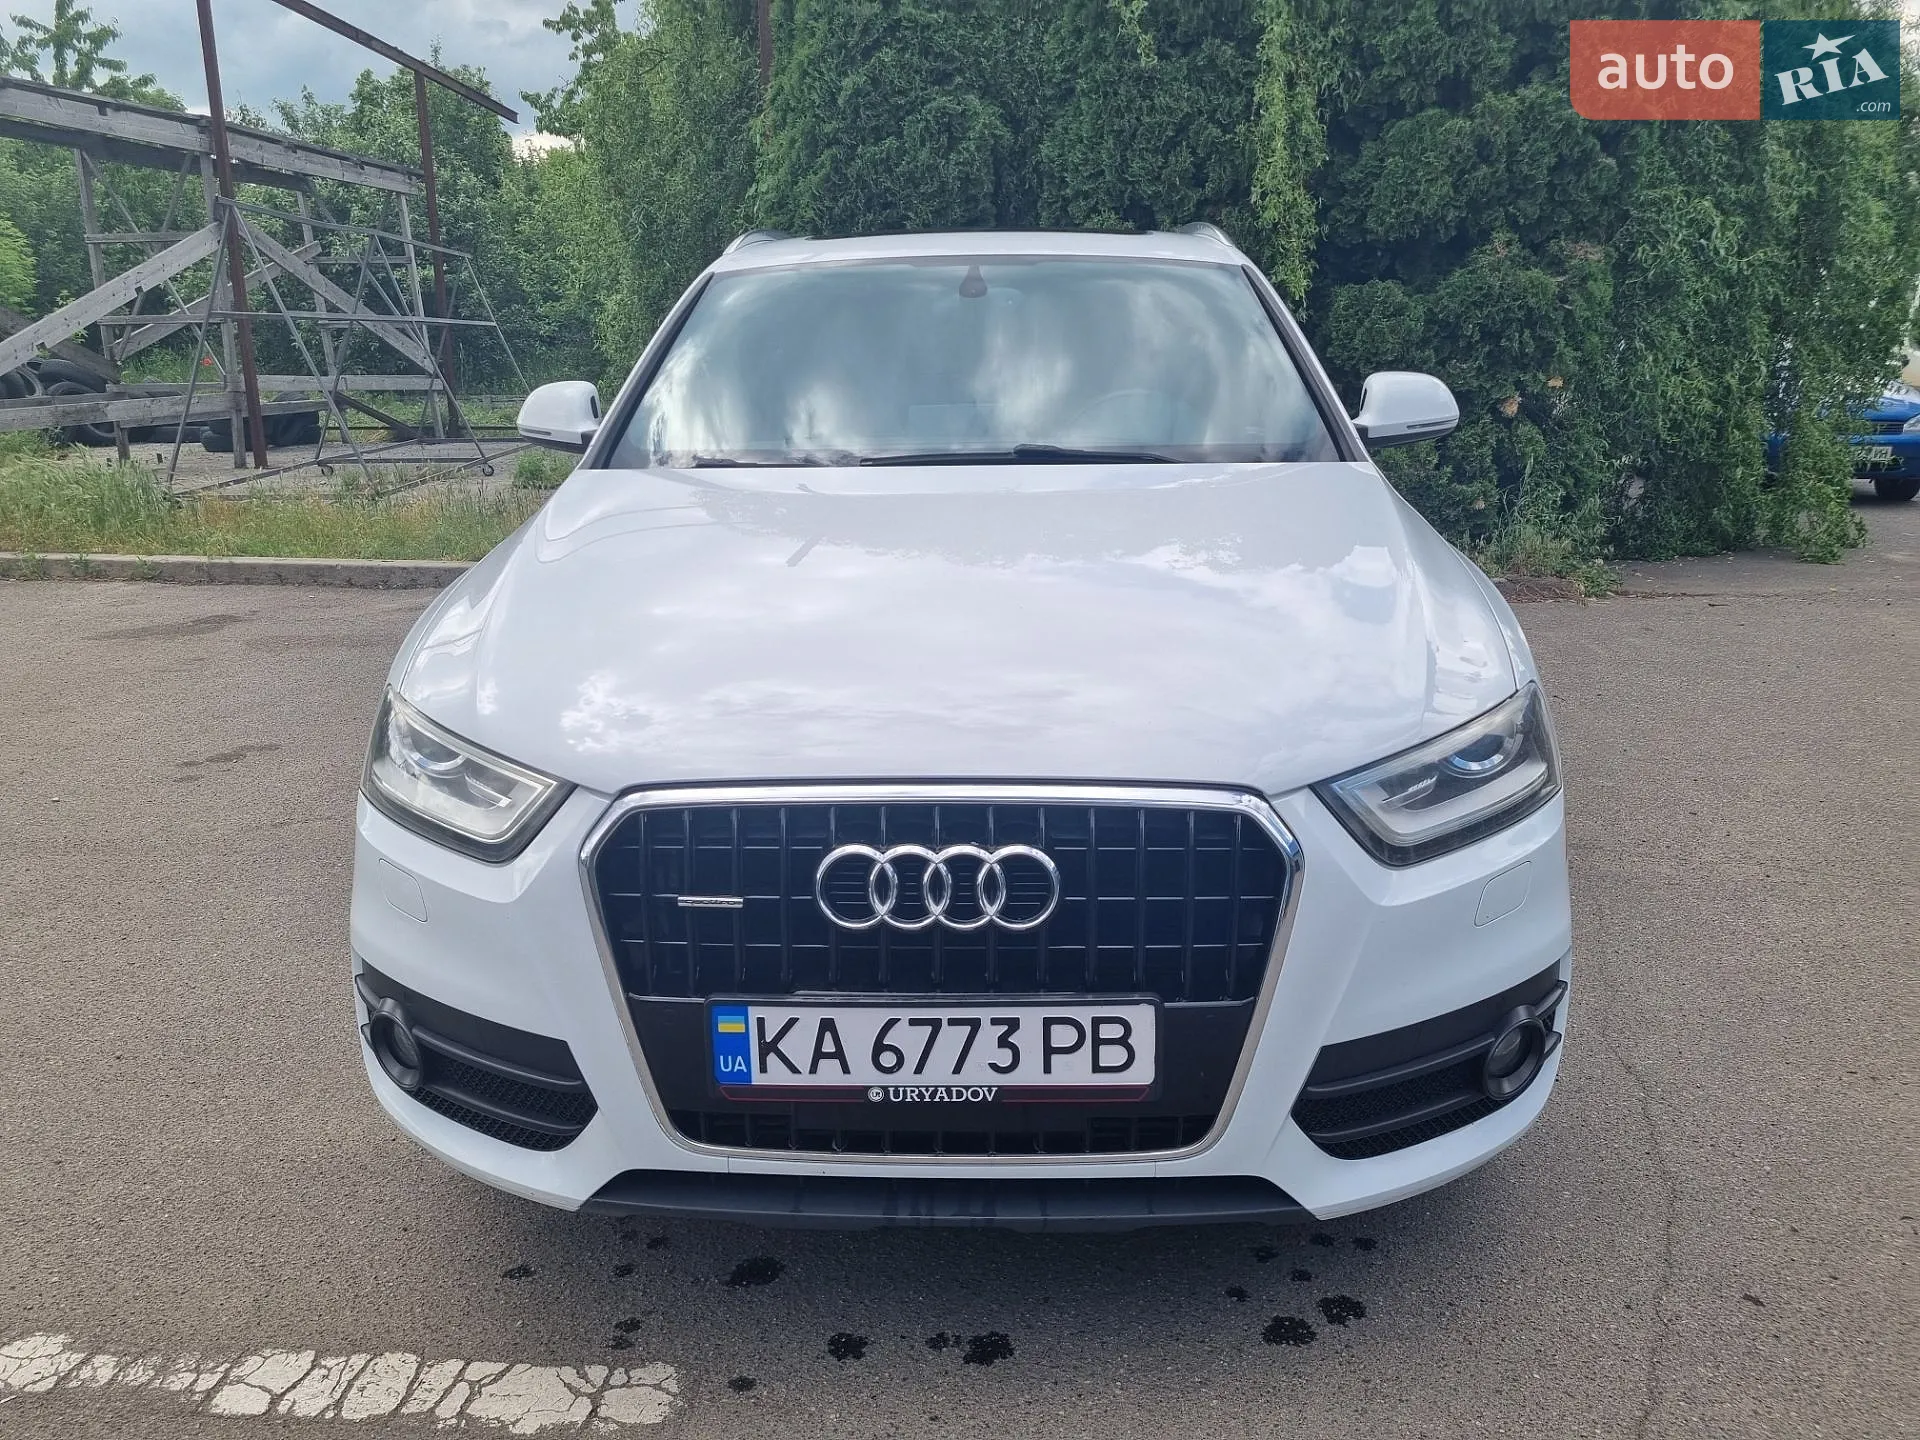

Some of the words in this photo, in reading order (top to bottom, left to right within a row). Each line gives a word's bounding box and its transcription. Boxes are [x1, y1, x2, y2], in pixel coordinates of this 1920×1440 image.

[756, 1016, 851, 1075] KA
[871, 1017, 1021, 1075] 6773
[1042, 1016, 1136, 1074] PB
[720, 1056, 748, 1073] UA
[888, 1087, 998, 1102] URYADOV
